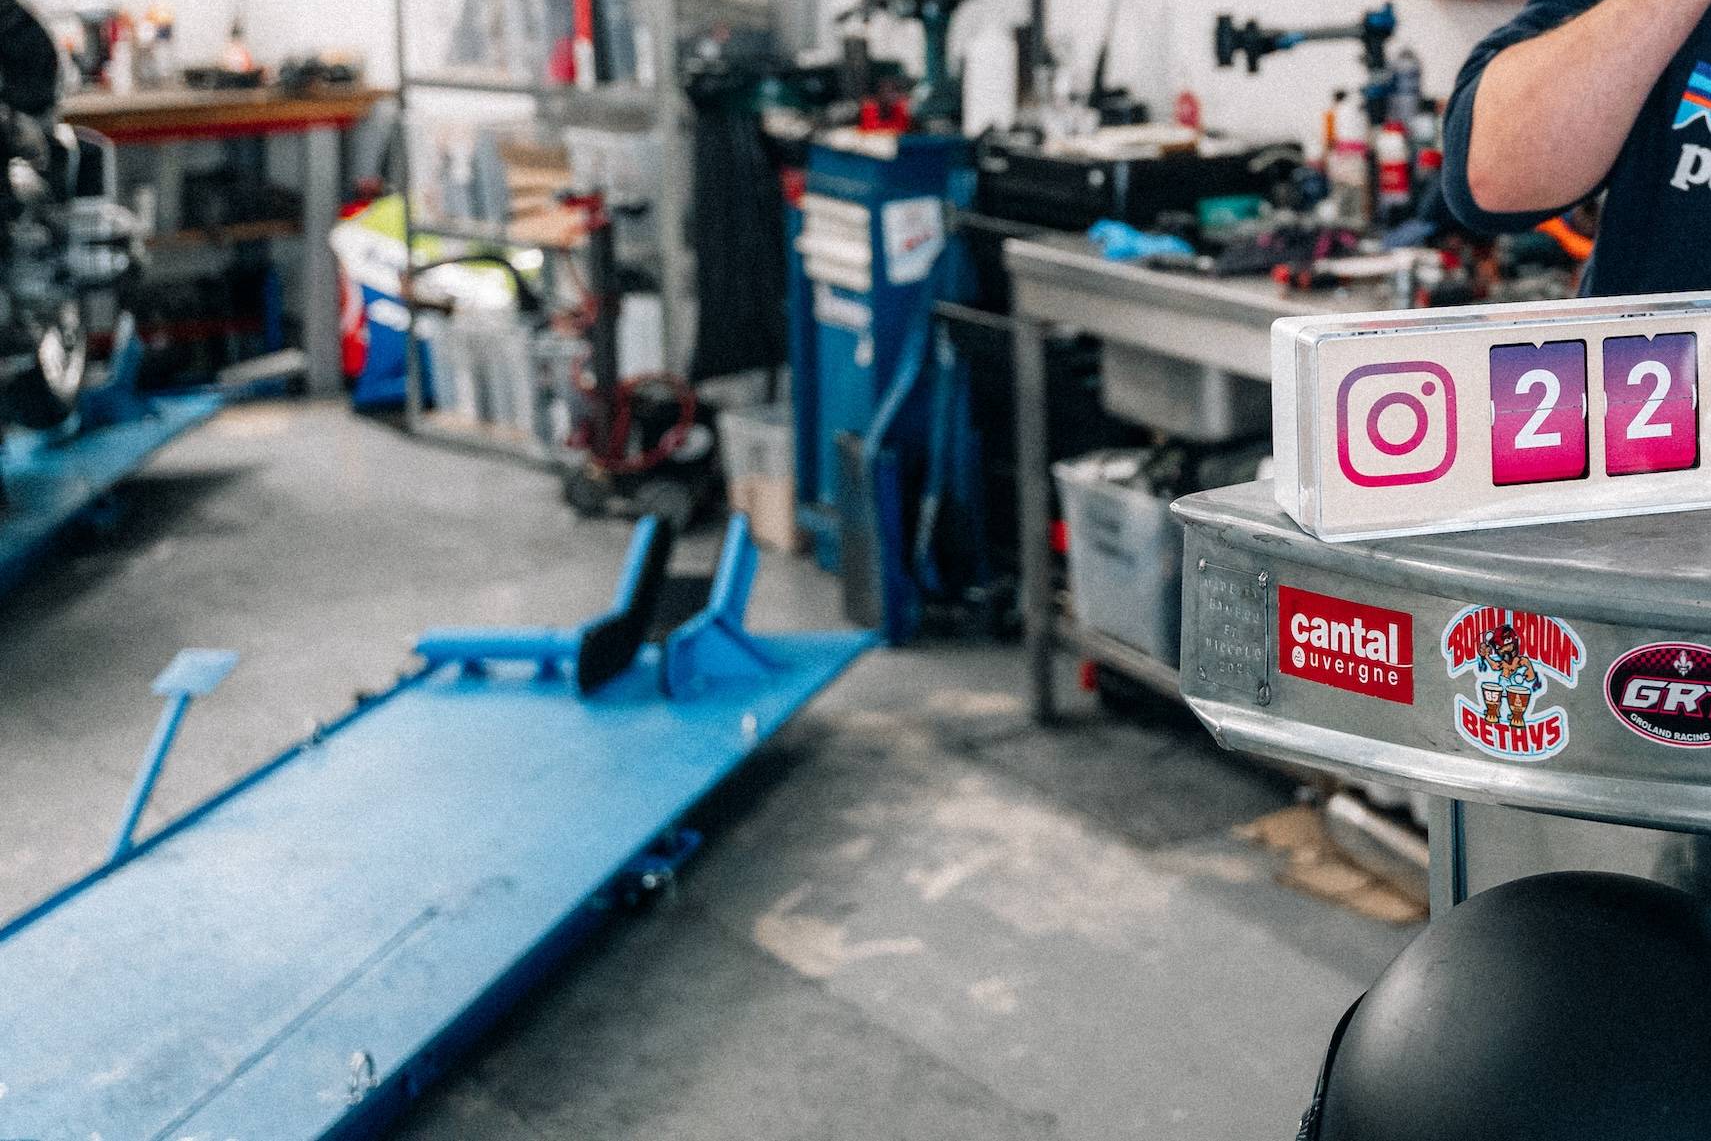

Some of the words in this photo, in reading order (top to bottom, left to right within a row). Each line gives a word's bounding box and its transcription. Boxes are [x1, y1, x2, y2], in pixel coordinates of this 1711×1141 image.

[1290, 612, 1399, 665] cantal
[1629, 712, 1673, 740] GROLAND
[1673, 732, 1711, 743] RACING
